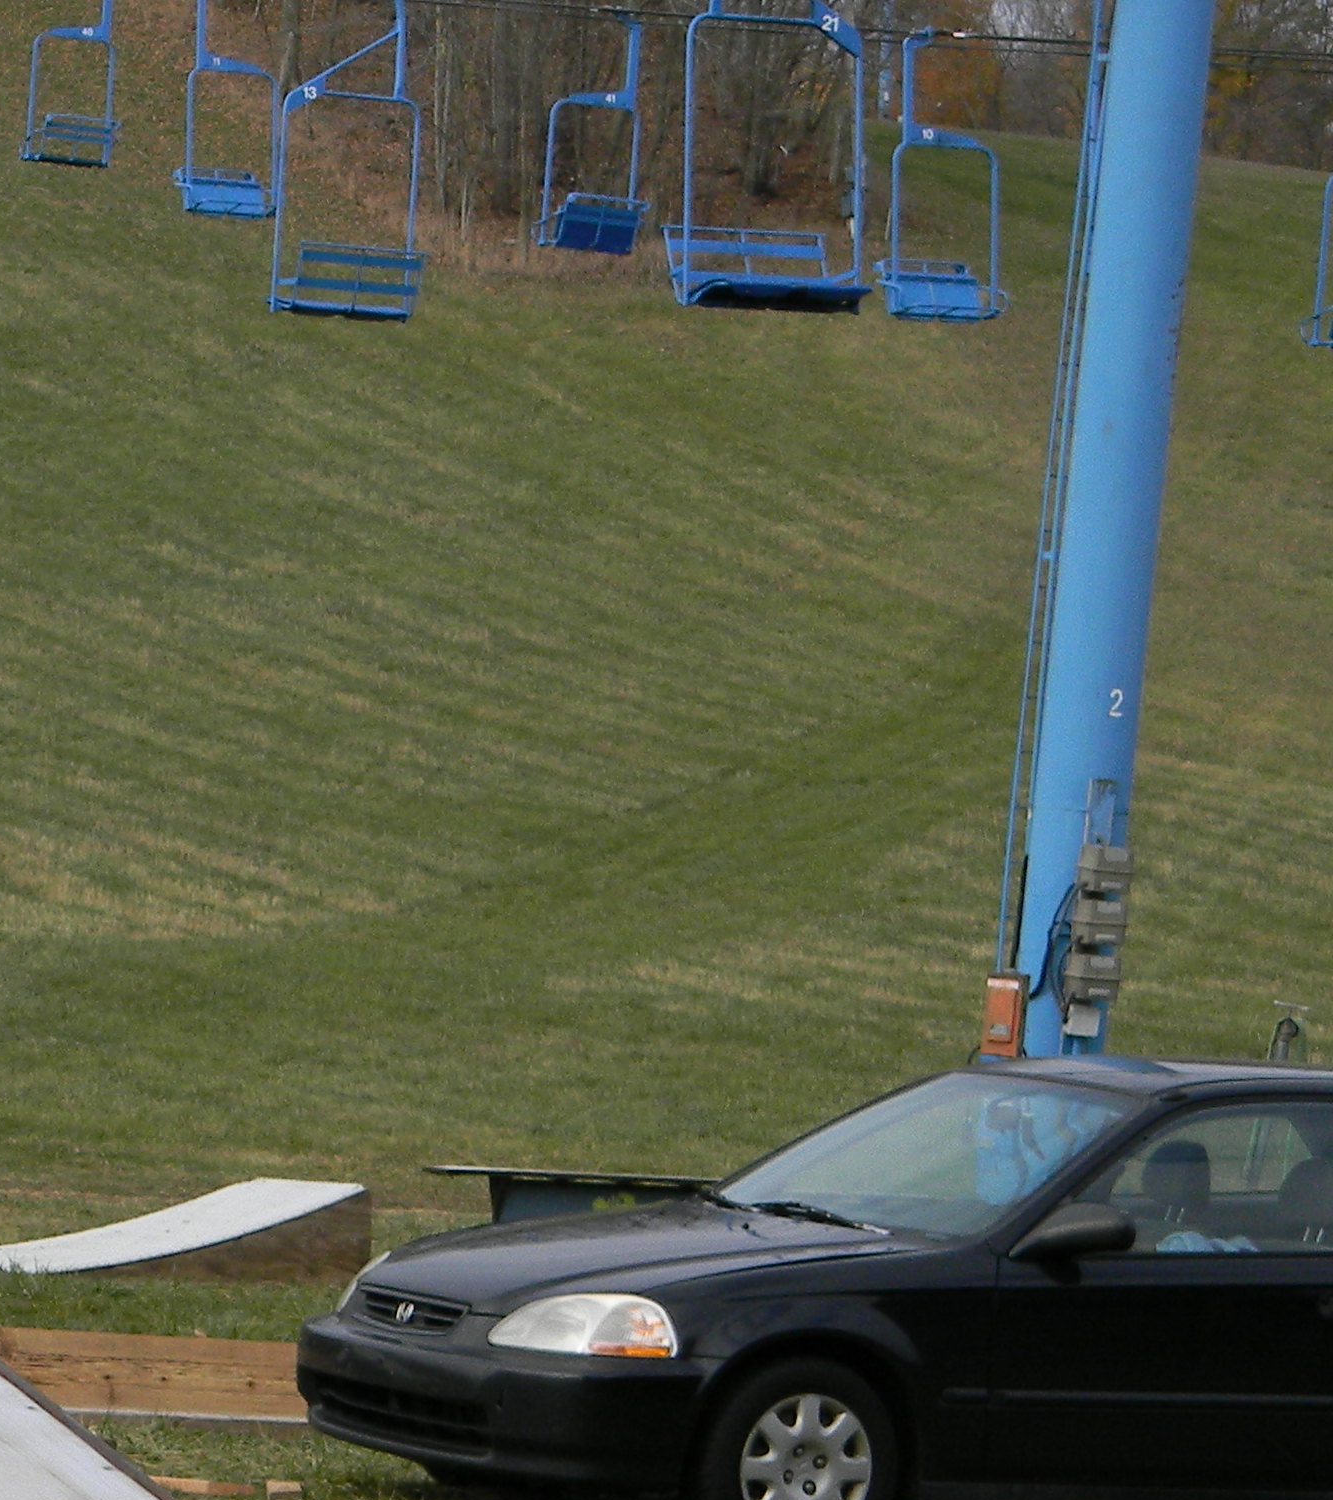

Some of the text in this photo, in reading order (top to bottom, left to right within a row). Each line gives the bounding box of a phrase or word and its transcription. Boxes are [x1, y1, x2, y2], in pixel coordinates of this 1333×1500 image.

[821, 14, 840, 32] 21
[303, 86, 317, 100] 13
[922, 128, 934, 140] 10
[1109, 688, 1124, 717] 2
